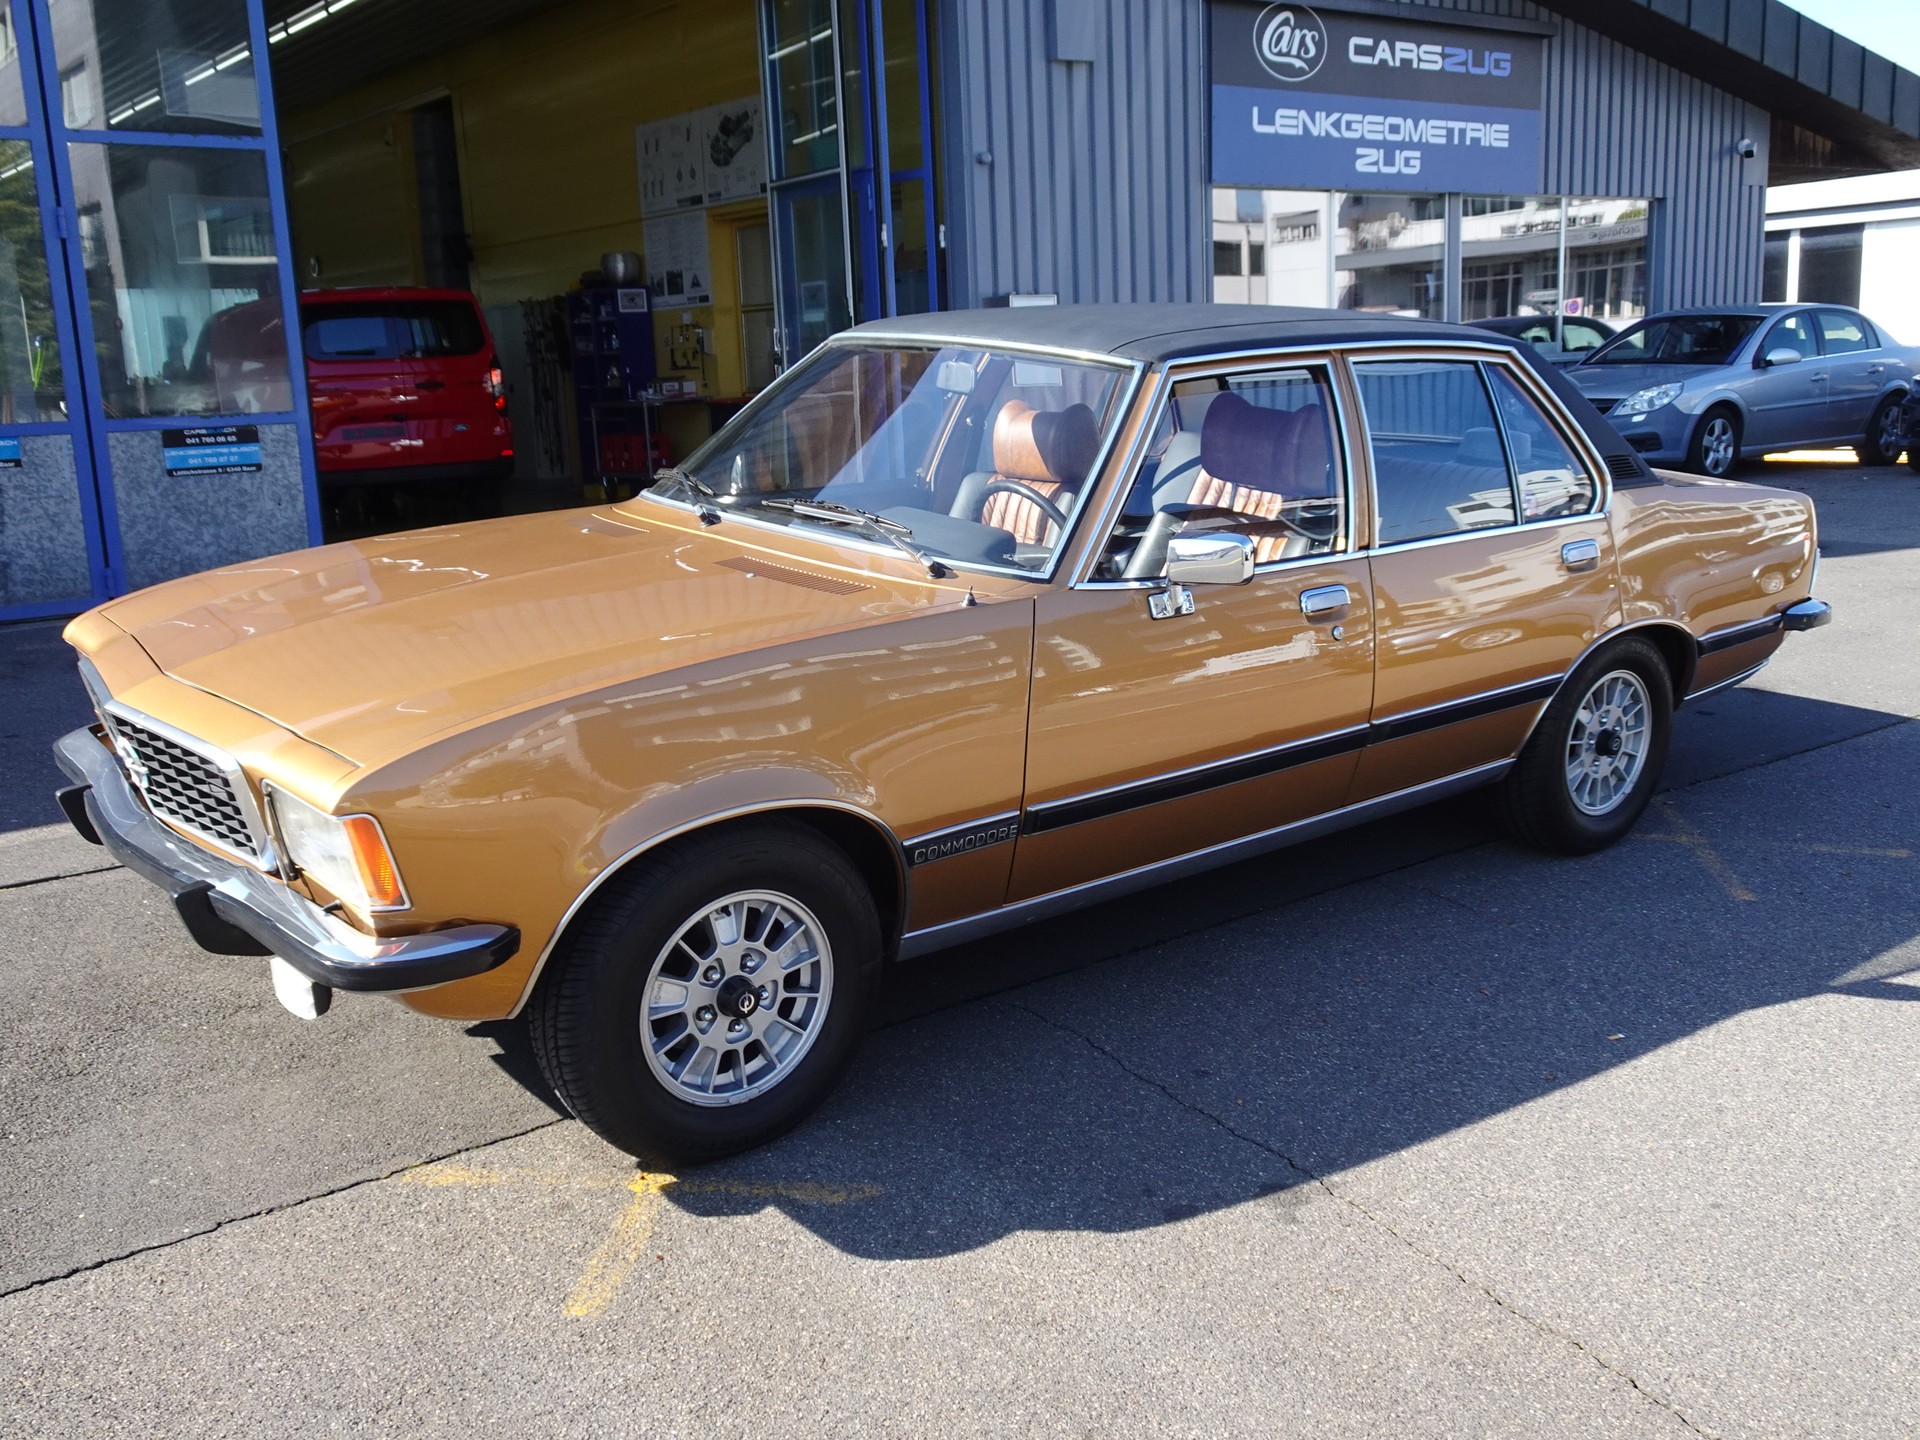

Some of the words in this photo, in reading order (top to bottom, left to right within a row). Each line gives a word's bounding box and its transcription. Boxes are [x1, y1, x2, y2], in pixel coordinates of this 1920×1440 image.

[1261, 10, 1319, 73] Cars
[1252, 106, 1510, 148] LENKGEOMETRIE
[1355, 147, 1421, 175] ZUG
[914, 824, 1018, 863] COMMODORE
